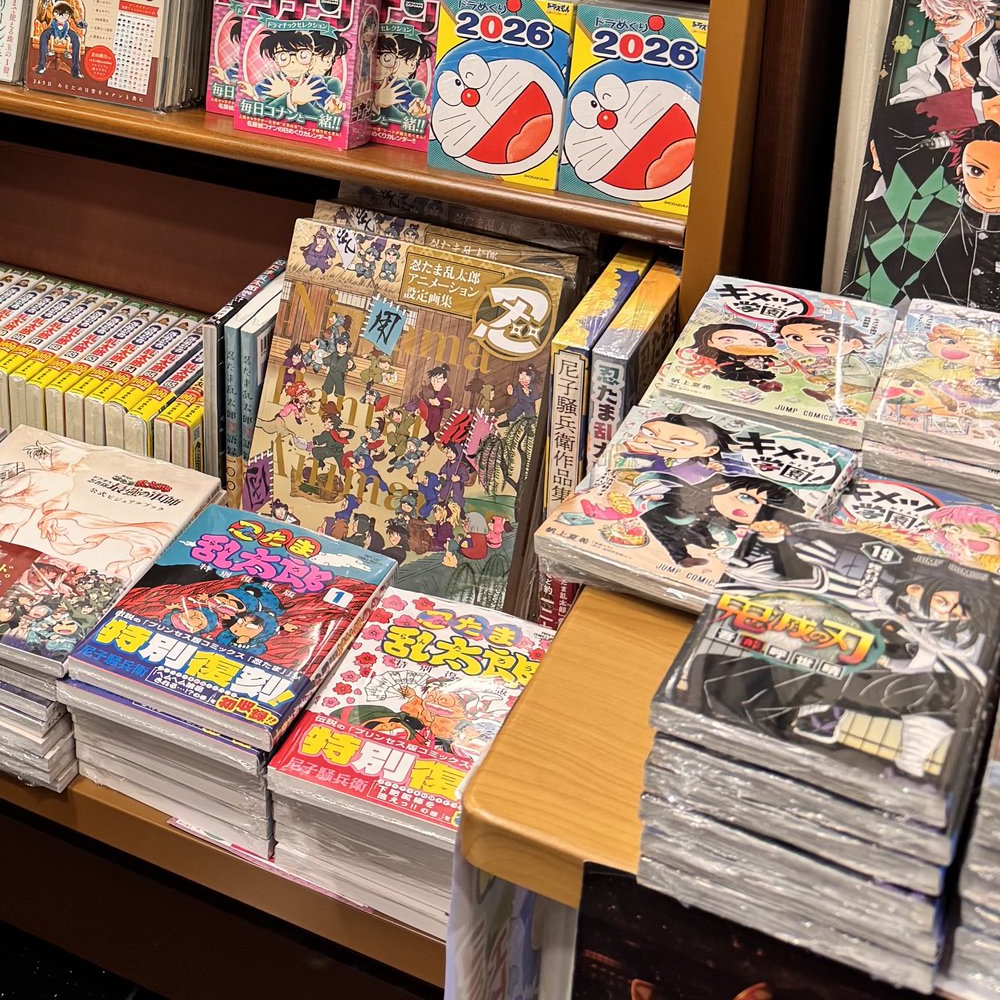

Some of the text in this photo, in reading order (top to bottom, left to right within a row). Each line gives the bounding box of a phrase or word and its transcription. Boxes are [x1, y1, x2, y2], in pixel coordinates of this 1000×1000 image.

[266, 20, 329, 31] ドラマチックセレクション
[455, 10, 553, 48] 2026
[594, 16, 648, 33] ドラめくり
[592, 29, 698, 69] 2026
[239, 99, 342, 131] 毎日コナンと一緒!!
[408, 258, 482, 284] 忍たま乱太郎
[403, 285, 453, 309] 設定画集
[407, 273, 480, 298] アニメーション
[715, 283, 802, 307] キメツ
[733, 300, 798, 320] 学園!
[775, 403, 835, 422] JUMP COMICS
[551, 359, 580, 505] 尼子騒兵衛作品集
[736, 431, 836, 469] キメツ
[756, 457, 826, 484] 学園!
[852, 482, 938, 514] キメツ
[188, 533, 335, 594] 乱太郎
[869, 545, 895, 562] 19
[655, 562, 683, 575] JUMP
[332, 590, 346, 603] 1
[711, 592, 878, 665] 鬼滅の刃
[95, 617, 296, 708] 特別復刻!
[382, 625, 541, 688] 乱太郎
